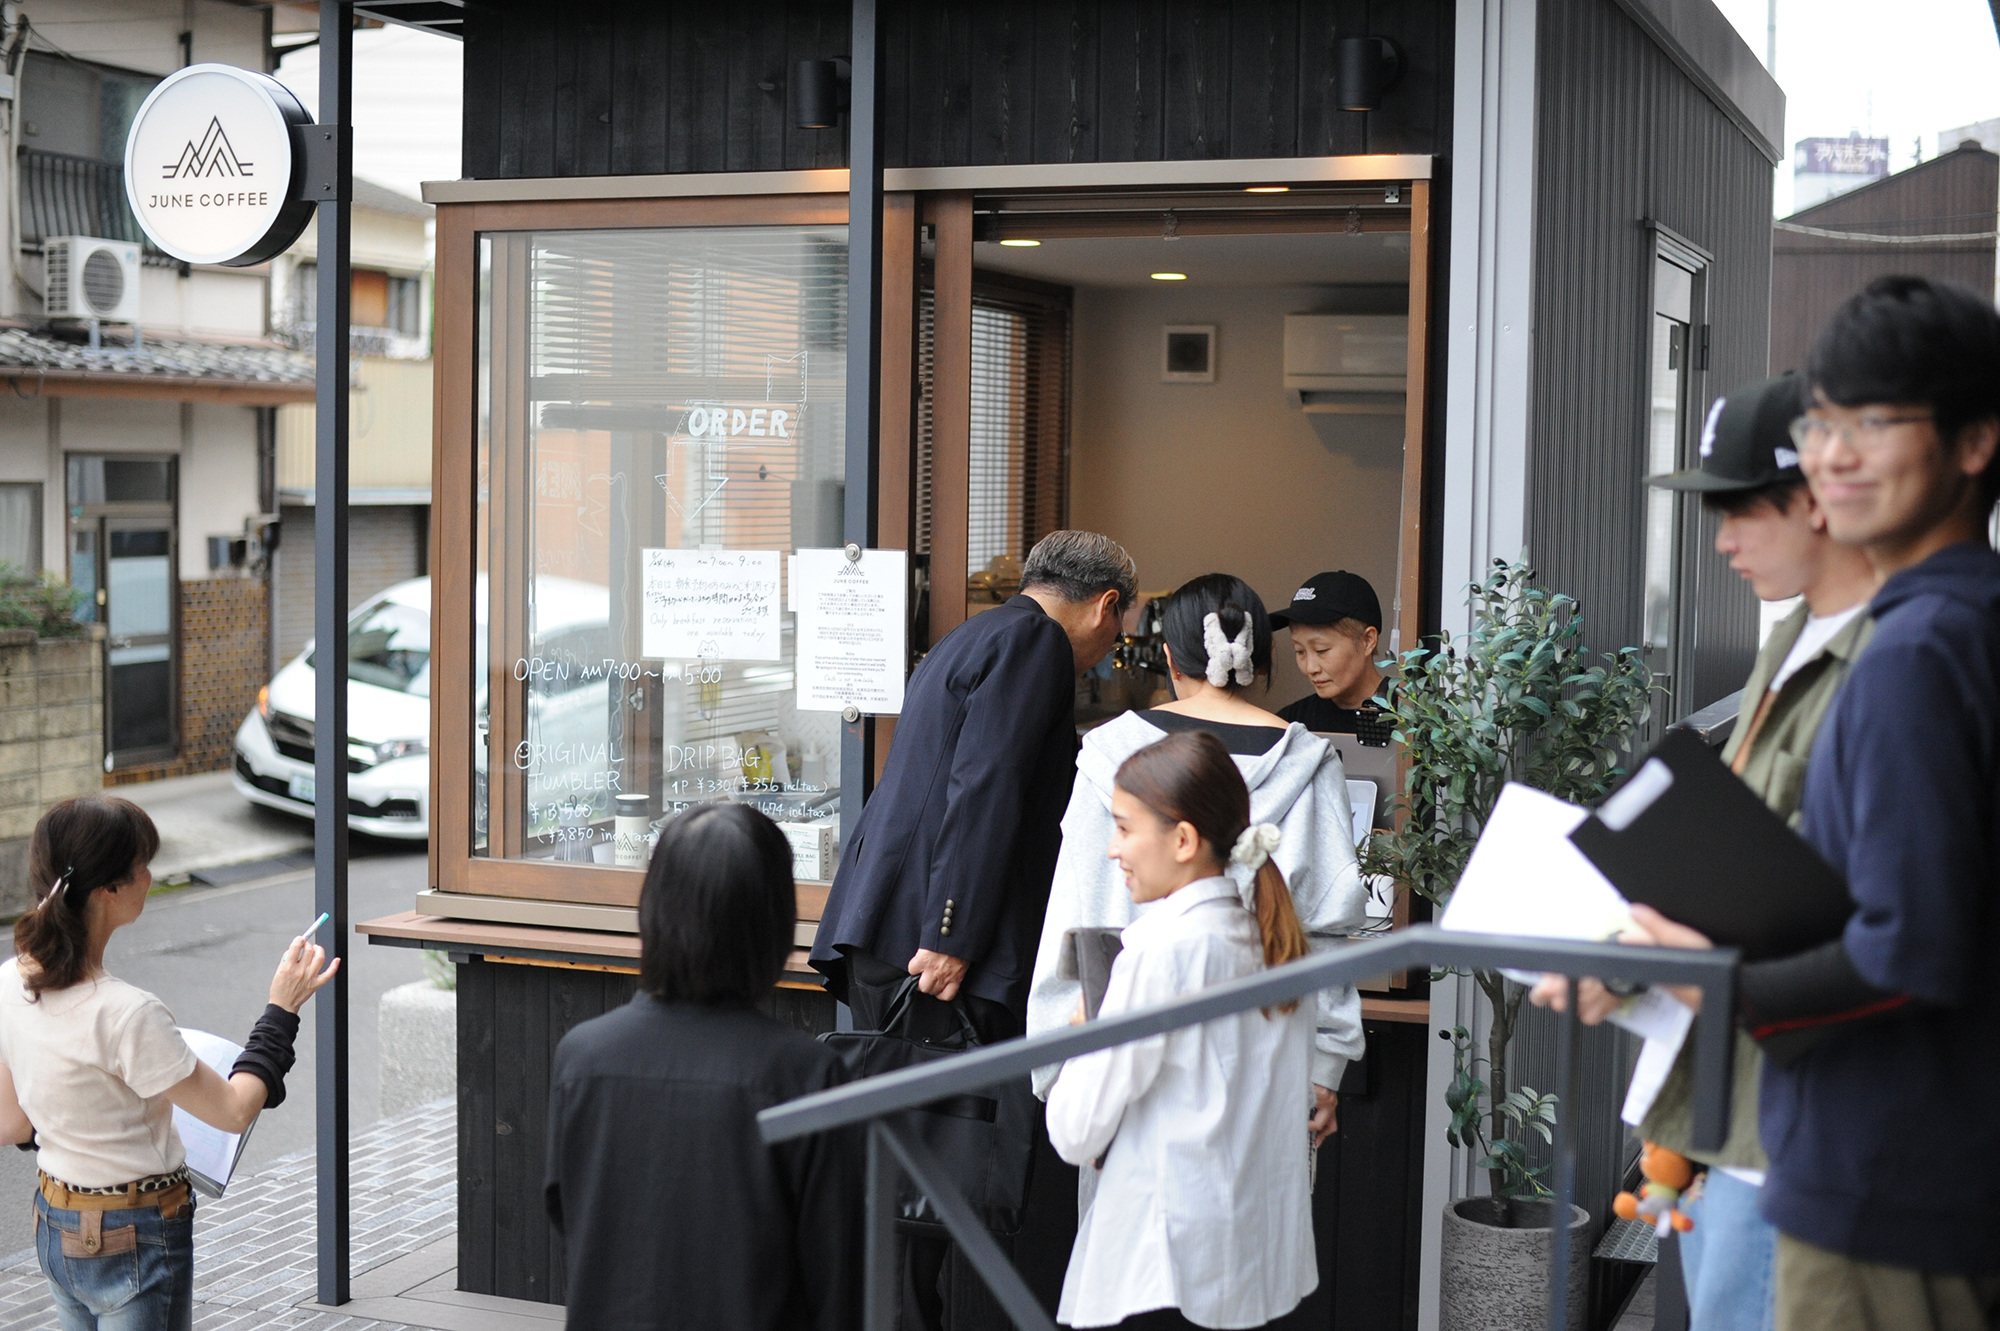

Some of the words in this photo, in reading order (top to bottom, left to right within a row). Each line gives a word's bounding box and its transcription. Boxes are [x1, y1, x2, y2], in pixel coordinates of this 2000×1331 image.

[149, 195, 193, 208] JUNE
[200, 192, 267, 206] COFFEE
[688, 407, 789, 438] ORDER
[650, 613, 667, 629] Only
[673, 613, 705, 625] breakfast
[713, 616, 757, 625] reservations
[706, 627, 733, 637] available
[514, 658, 570, 681] OPEN
[514, 740, 624, 770] ORIGINAL
[667, 745, 715, 773] DRIP
[722, 745, 761, 771] BAG
[529, 771, 622, 791] TUMBLER
[671, 780, 689, 795] 1P
